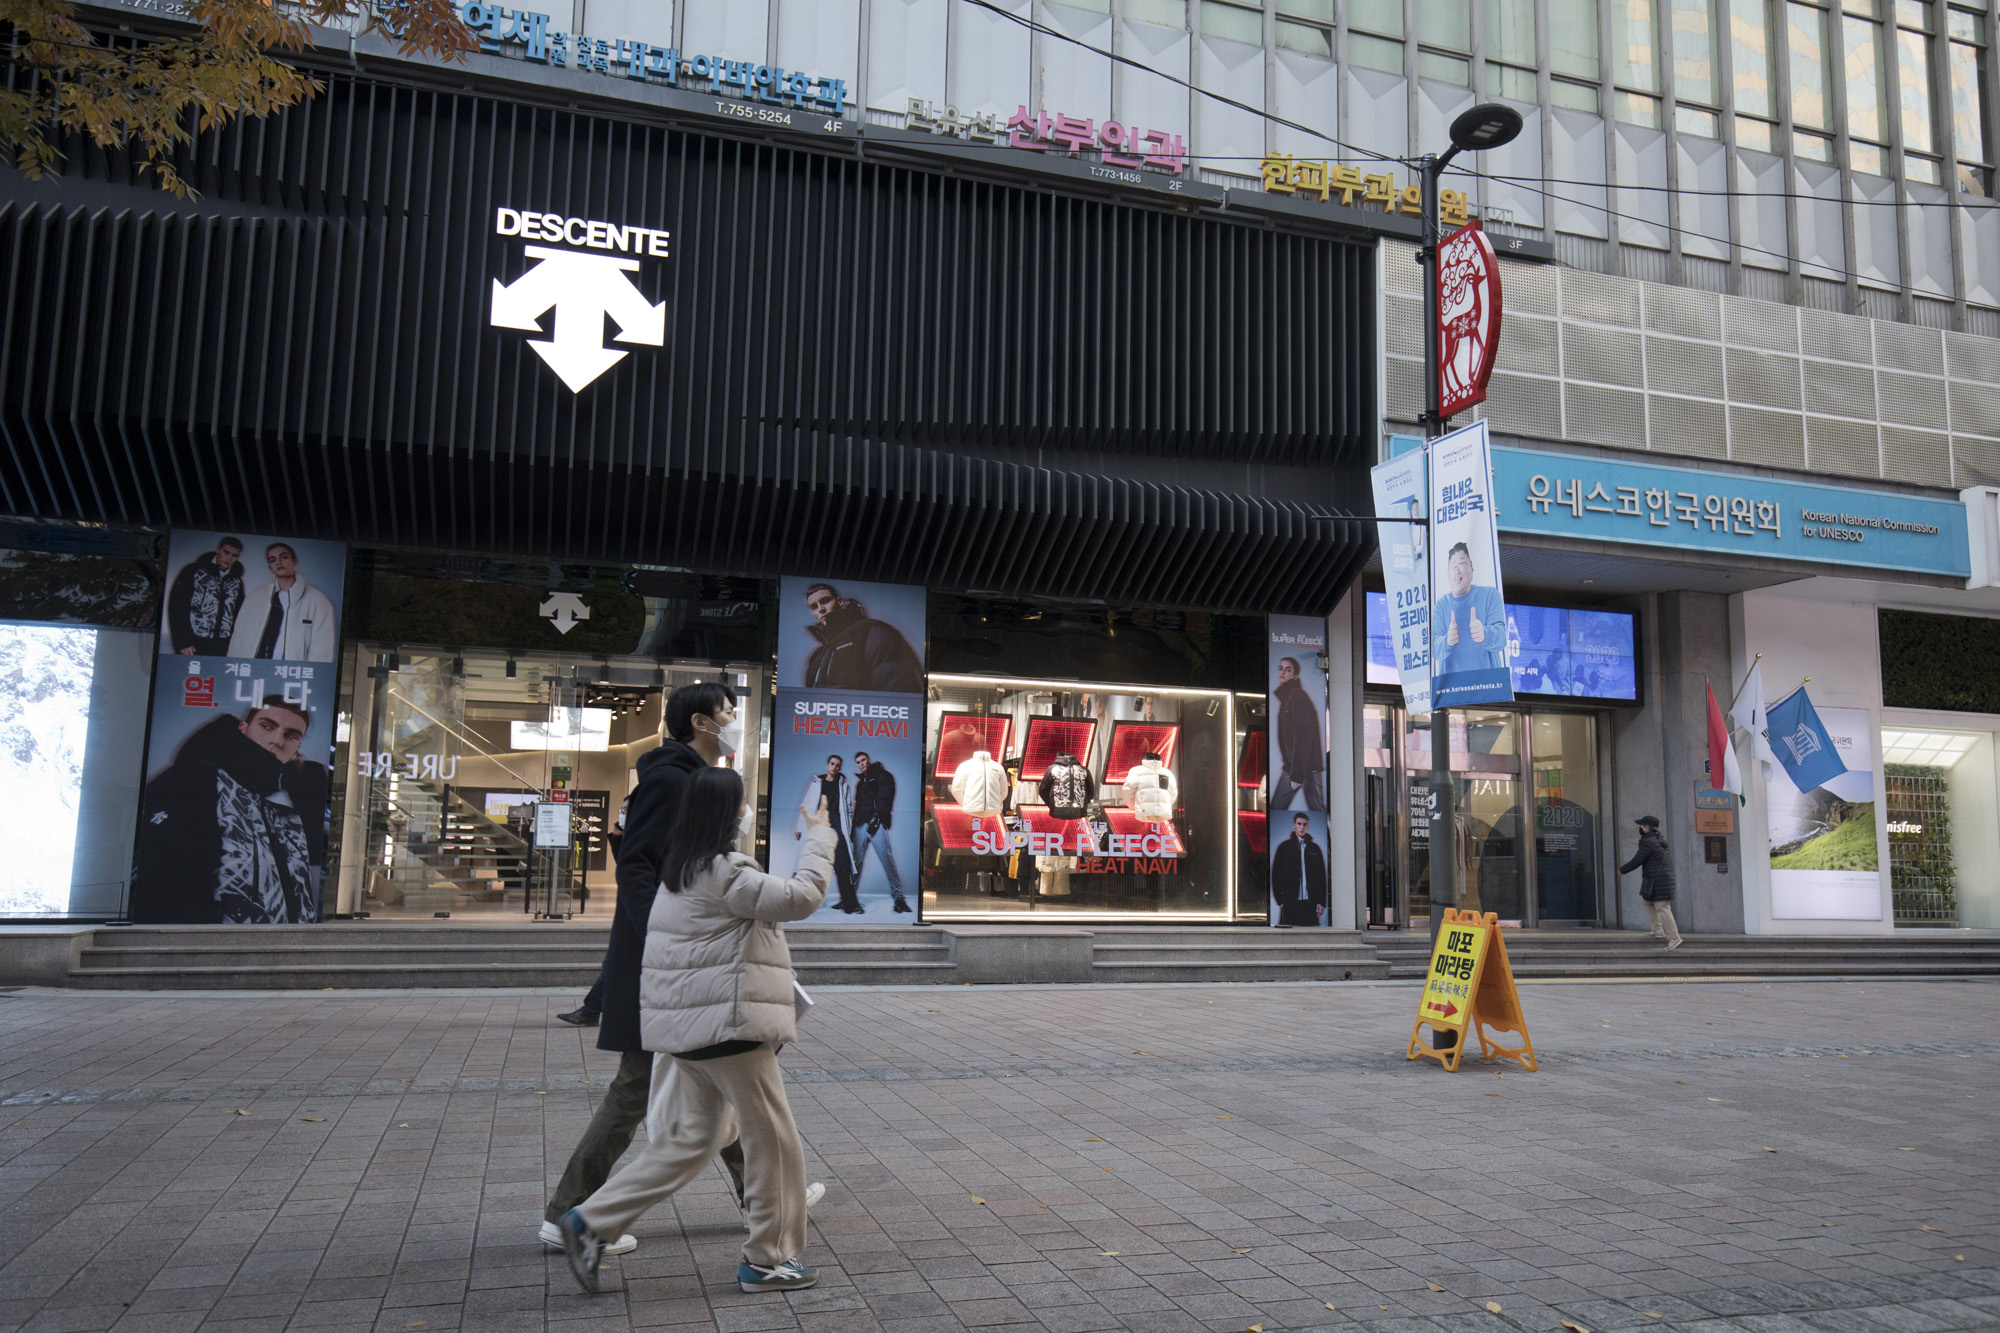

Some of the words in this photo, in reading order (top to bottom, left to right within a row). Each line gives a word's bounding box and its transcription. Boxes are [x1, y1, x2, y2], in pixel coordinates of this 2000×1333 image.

[823, 119, 843, 133] 4F
[1007, 105, 1187, 176] 산부인과
[1168, 179, 1183, 191] 2F
[496, 207, 670, 258] DESCENTE
[1508, 239, 1523, 250] 3F
[1442, 477, 1474, 504] 힘내요
[1436, 493, 1484, 524] 대한민국
[1527, 474, 1782, 538] 유네스코한국위원회
[1801, 508, 1838, 524] Korean
[1840, 513, 1880, 528] National
[1882, 517, 1940, 535] Commission
[1802, 525, 1816, 537] for
[1818, 527, 1865, 543] UNESCO
[1396, 583, 1427, 609] 2020
[1399, 605, 1429, 629] 코리아
[1402, 631, 1412, 650] 세
[1421, 627, 1429, 646] 일
[1585, 645, 1619, 665] 2020
[225, 662, 252, 677] 겨울
[274, 665, 314, 679] 제대로
[794, 701, 848, 716] SUPER
[851, 703, 909, 719] FLEECE
[793, 716, 853, 736] HEAT
[858, 719, 909, 739] NAVI
[1012, 819, 1033, 832] 겨울
[1543, 805, 1584, 828] 2020
[1886, 820, 1922, 834] nisfree
[971, 831, 1065, 856] SUPER
[1076, 833, 1178, 858] FLEECE
[1076, 857, 1129, 874] HEAT
[1133, 858, 1178, 875] NAVI
[1447, 931, 1475, 954] 마포
[1434, 954, 1475, 981] 마라탕
